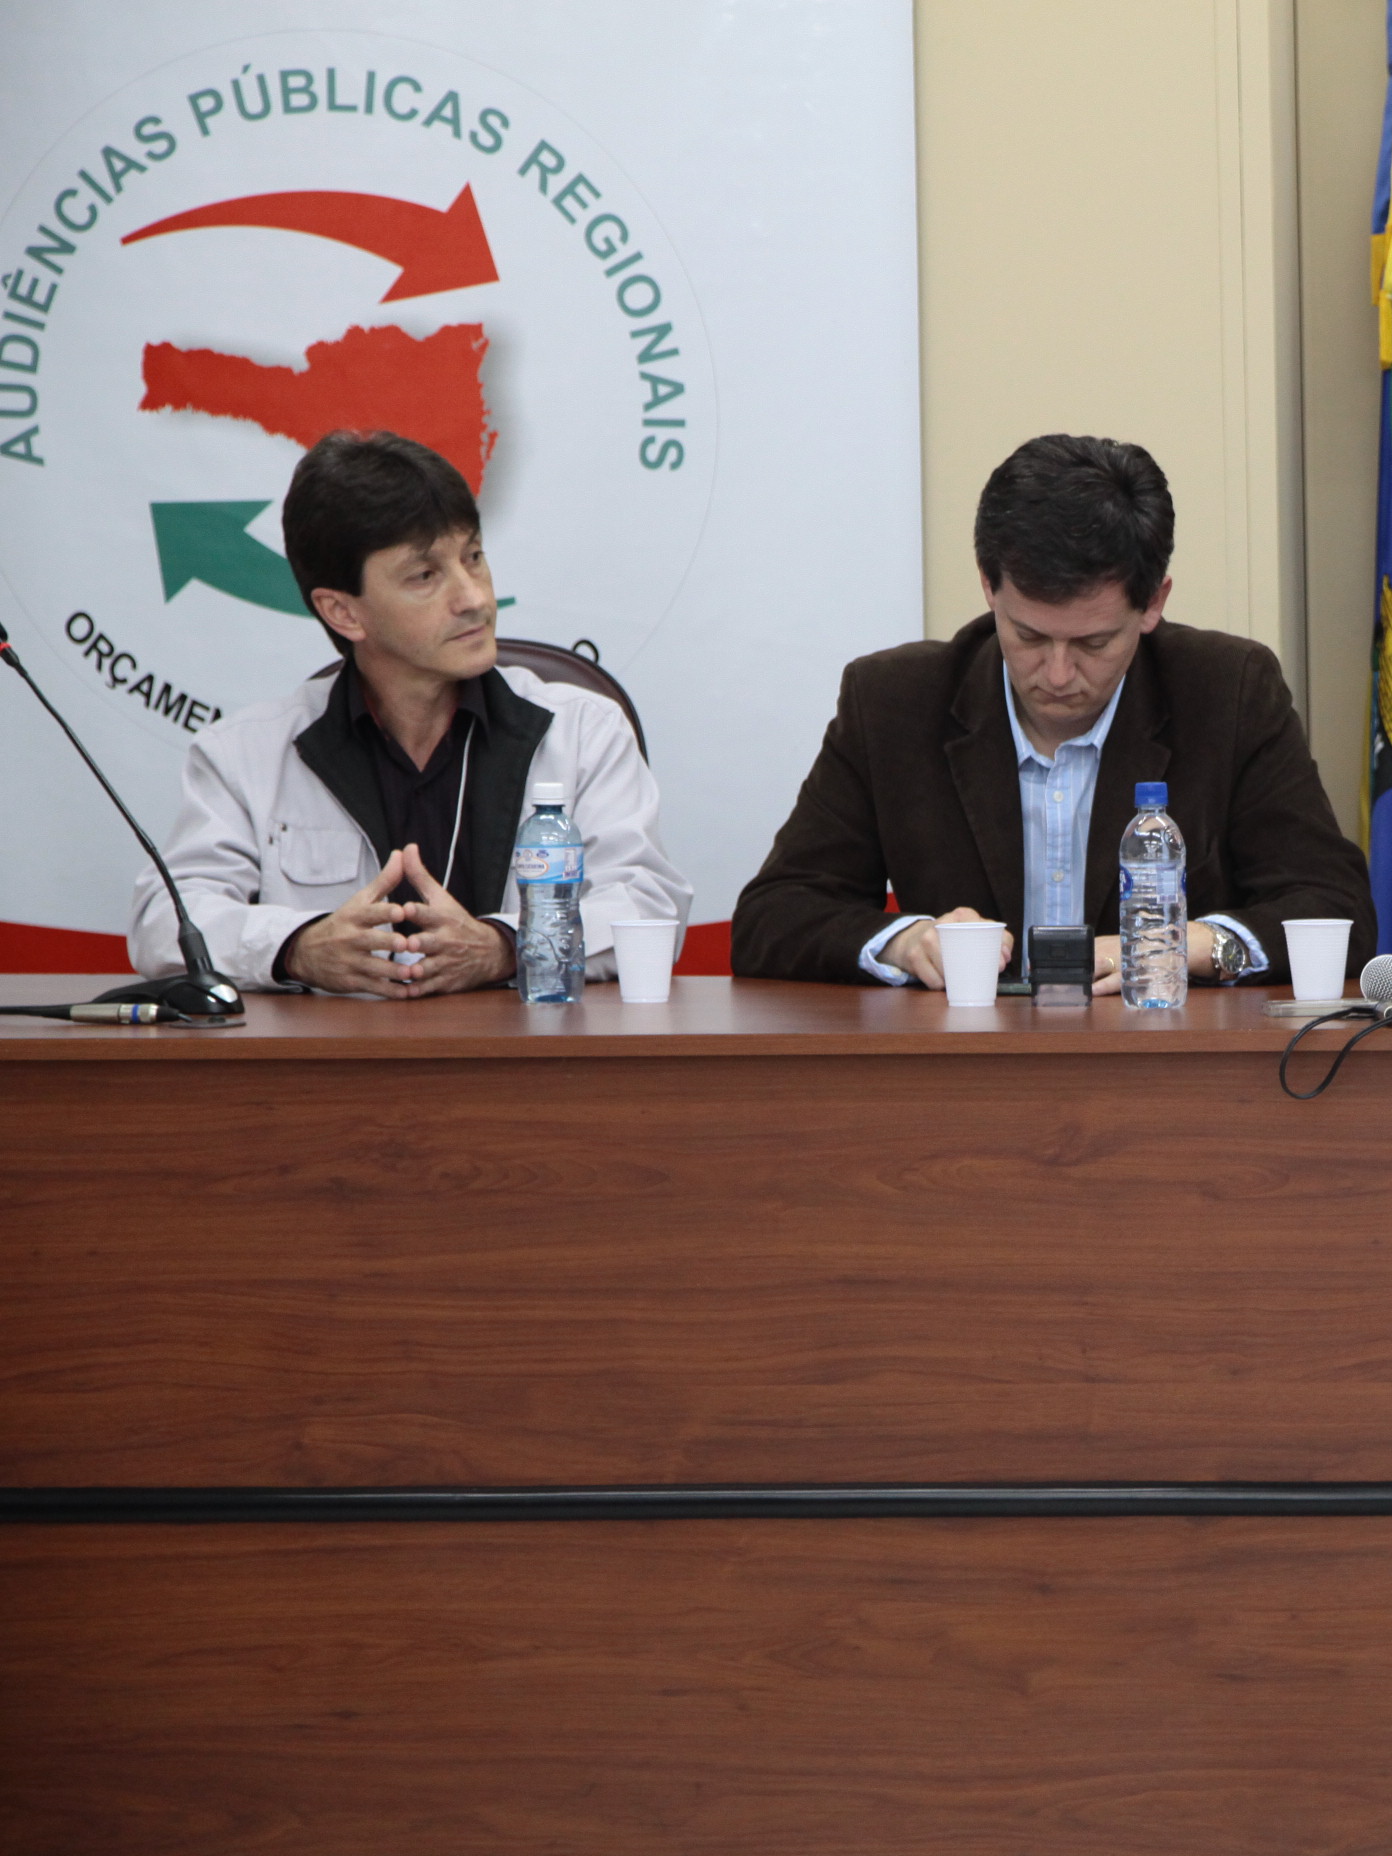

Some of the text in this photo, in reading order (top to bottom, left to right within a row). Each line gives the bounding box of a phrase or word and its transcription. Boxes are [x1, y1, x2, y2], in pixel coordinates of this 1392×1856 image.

[0, 63, 686, 471] AUDIÊNCIAS PÚBLICAS REGIONAIS
